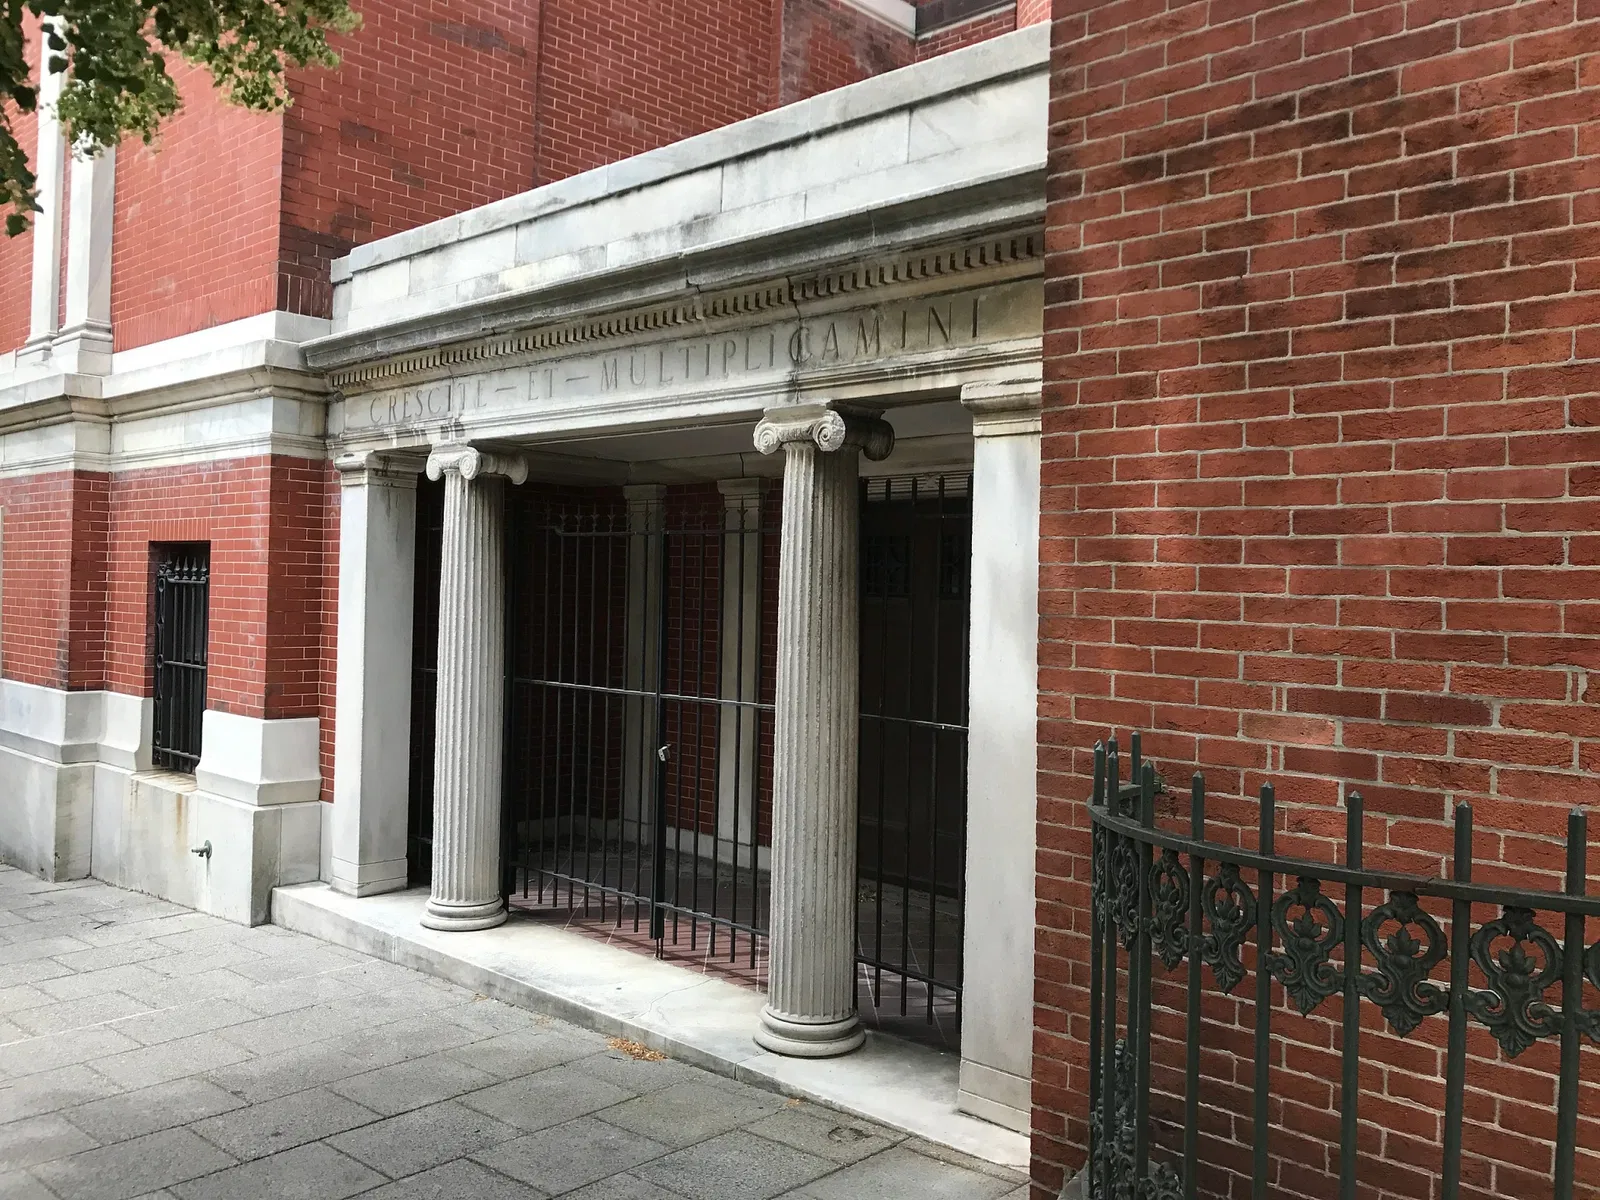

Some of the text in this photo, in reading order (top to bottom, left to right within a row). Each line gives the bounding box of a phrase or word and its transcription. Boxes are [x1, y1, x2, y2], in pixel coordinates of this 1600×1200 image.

[369, 379, 488, 424] CRESCITE
[527, 367, 560, 401] ET
[600, 297, 985, 391] MULTIPLICAMINI
